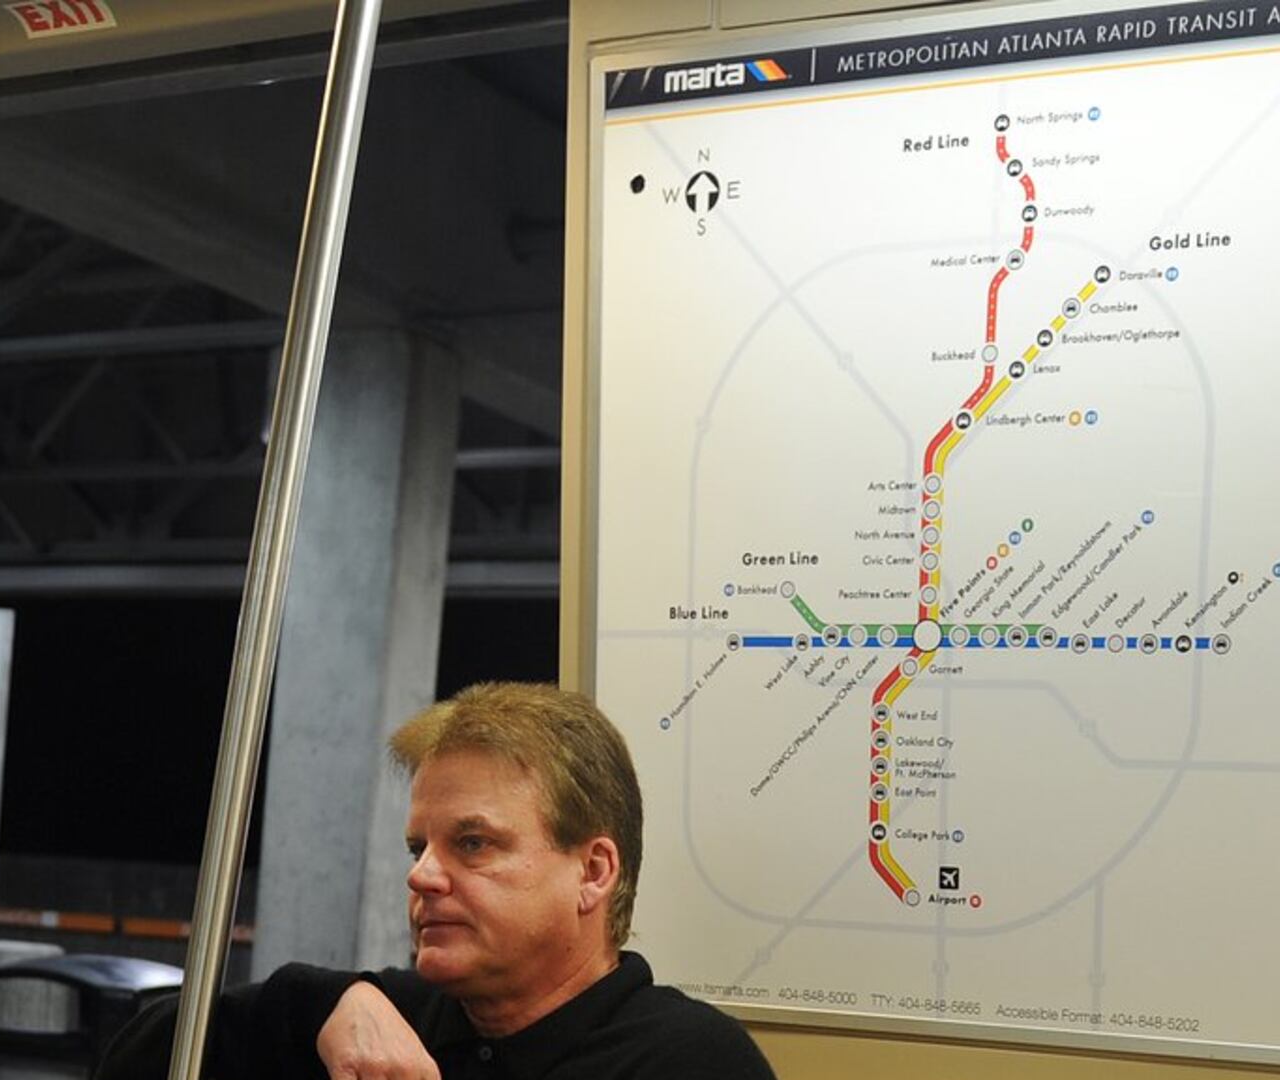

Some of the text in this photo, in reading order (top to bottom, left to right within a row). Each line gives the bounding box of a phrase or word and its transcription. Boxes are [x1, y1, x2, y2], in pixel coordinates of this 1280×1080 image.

[13, 0, 105, 32] EXIT
[837, 38, 989, 73] METROPOLITAN
[998, 29, 1087, 55] ATLANTA
[1096, 19, 1158, 43] RAPID
[1167, 10, 1256, 36] TRANSIT
[664, 60, 745, 94] marta
[1017, 111, 1083, 125] North Springs
[903, 134, 969, 152] Red Line
[698, 149, 711, 163] N
[1032, 154, 1100, 168] Sandy Springs
[662, 187, 681, 203] W
[727, 182, 740, 200] E
[1044, 205, 1095, 217] Dunwoody
[697, 218, 706, 236] S
[1149, 232, 1231, 250] Gold Line
[931, 254, 1001, 267] Medical Center
[1119, 269, 1163, 281] Doraville
[1089, 303, 1138, 314] Chamblee
[1062, 329, 1180, 345] Brookhaven/Oglethorpe
[932, 350, 976, 361] Buckhead
[1033, 363, 1061, 374] Lenox
[986, 413, 1065, 427] Lindbergh Center
[868, 481, 917, 491] Arts Center
[878, 505, 916, 515] Midtown
[855, 530, 915, 540] North Avenue
[742, 551, 819, 567] Green Line
[862, 555, 914, 565] Civic Center
[1051, 525, 1142, 619] Edgewood/Candler Park
[737, 584, 777, 595] Bankhead
[839, 589, 912, 600] Peachtree Center
[940, 569, 986, 618] Five Points
[964, 566, 1014, 618] Georgia State
[991, 560, 1045, 619] King Memorial
[1019, 594, 1042, 619] Inman
[1082, 592, 1118, 629] East Lake
[1152, 591, 1188, 629] Avondale
[1184, 586, 1228, 629] Kensington
[1220, 577, 1272, 629] Indian Creek
[669, 606, 729, 619] Blue Line
[1115, 598, 1145, 629] Decatur
[781, 655, 798, 673] Lake
[804, 656, 825, 678] Ashby
[818, 656, 850, 687] Vine City
[856, 656, 878, 679] Center
[897, 711, 938, 720] West End
[896, 737, 954, 749] Oakland City
[895, 759, 944, 769] Lakewood/
[909, 770, 956, 779] McPherson
[895, 788, 936, 797] East Point
[895, 829, 950, 841] College Park
[928, 894, 966, 905] Airport
[778, 988, 857, 1005] 404-848-5000
[871, 993, 893, 1006] TTY:
[898, 997, 981, 1015] 404-848-5665
[996, 1004, 1058, 1021] Accessible
[1062, 1008, 1105, 1025] Format:
[1109, 1013, 1200, 1033] 404-848-5202
